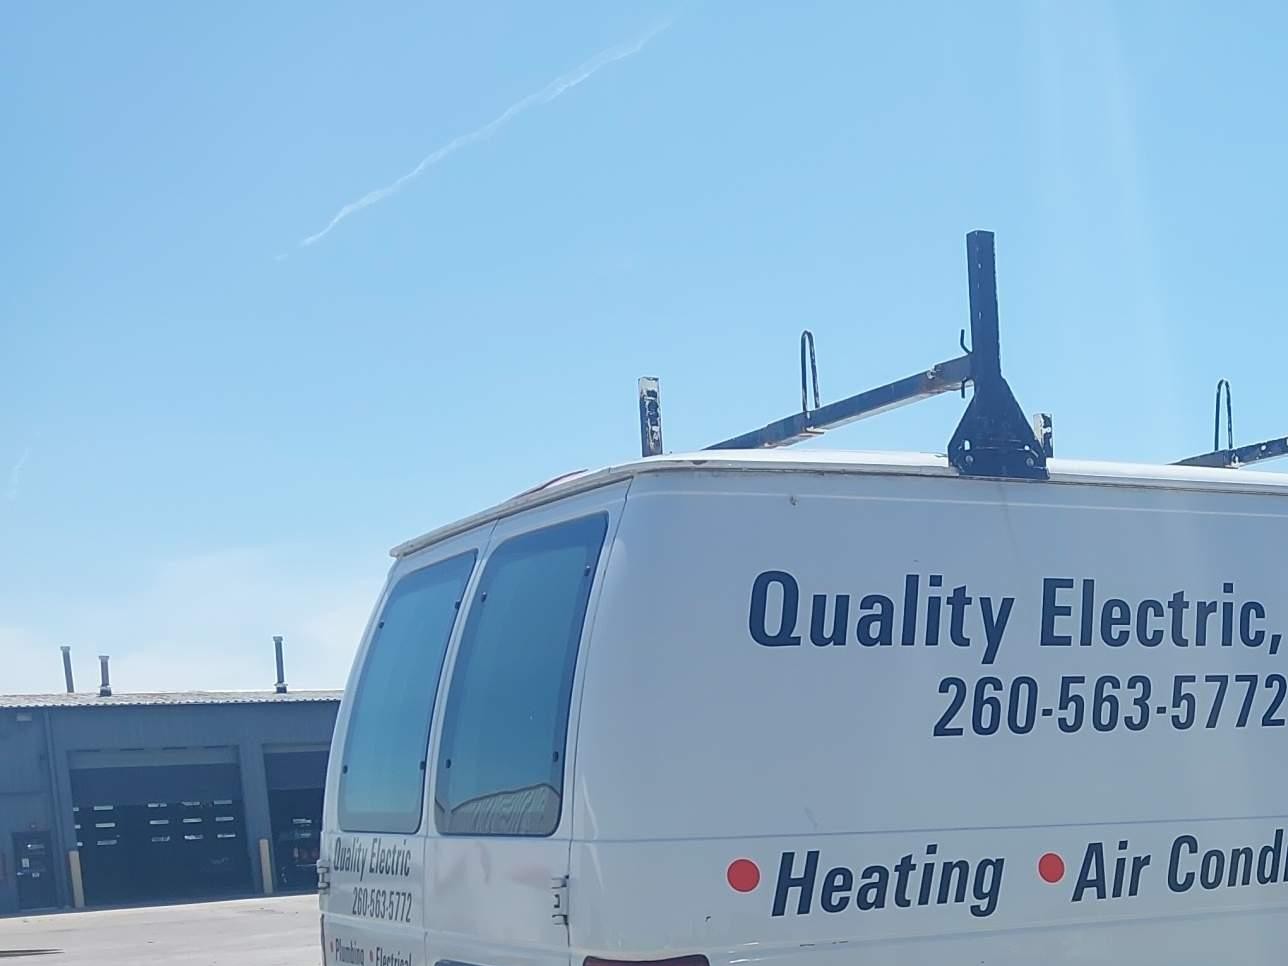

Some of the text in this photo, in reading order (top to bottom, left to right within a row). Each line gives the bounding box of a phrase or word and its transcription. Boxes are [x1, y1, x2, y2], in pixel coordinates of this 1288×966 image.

[748, 570, 1015, 665] Quality
[1039, 577, 1283, 655] Electric,
[933, 674, 1288, 737] 260-563-5772
[333, 837, 412, 881] Quality Electric
[771, 844, 1005, 917] Heating
[1072, 840, 1150, 902] Air
[352, 886, 412, 923] 260-563-5772
